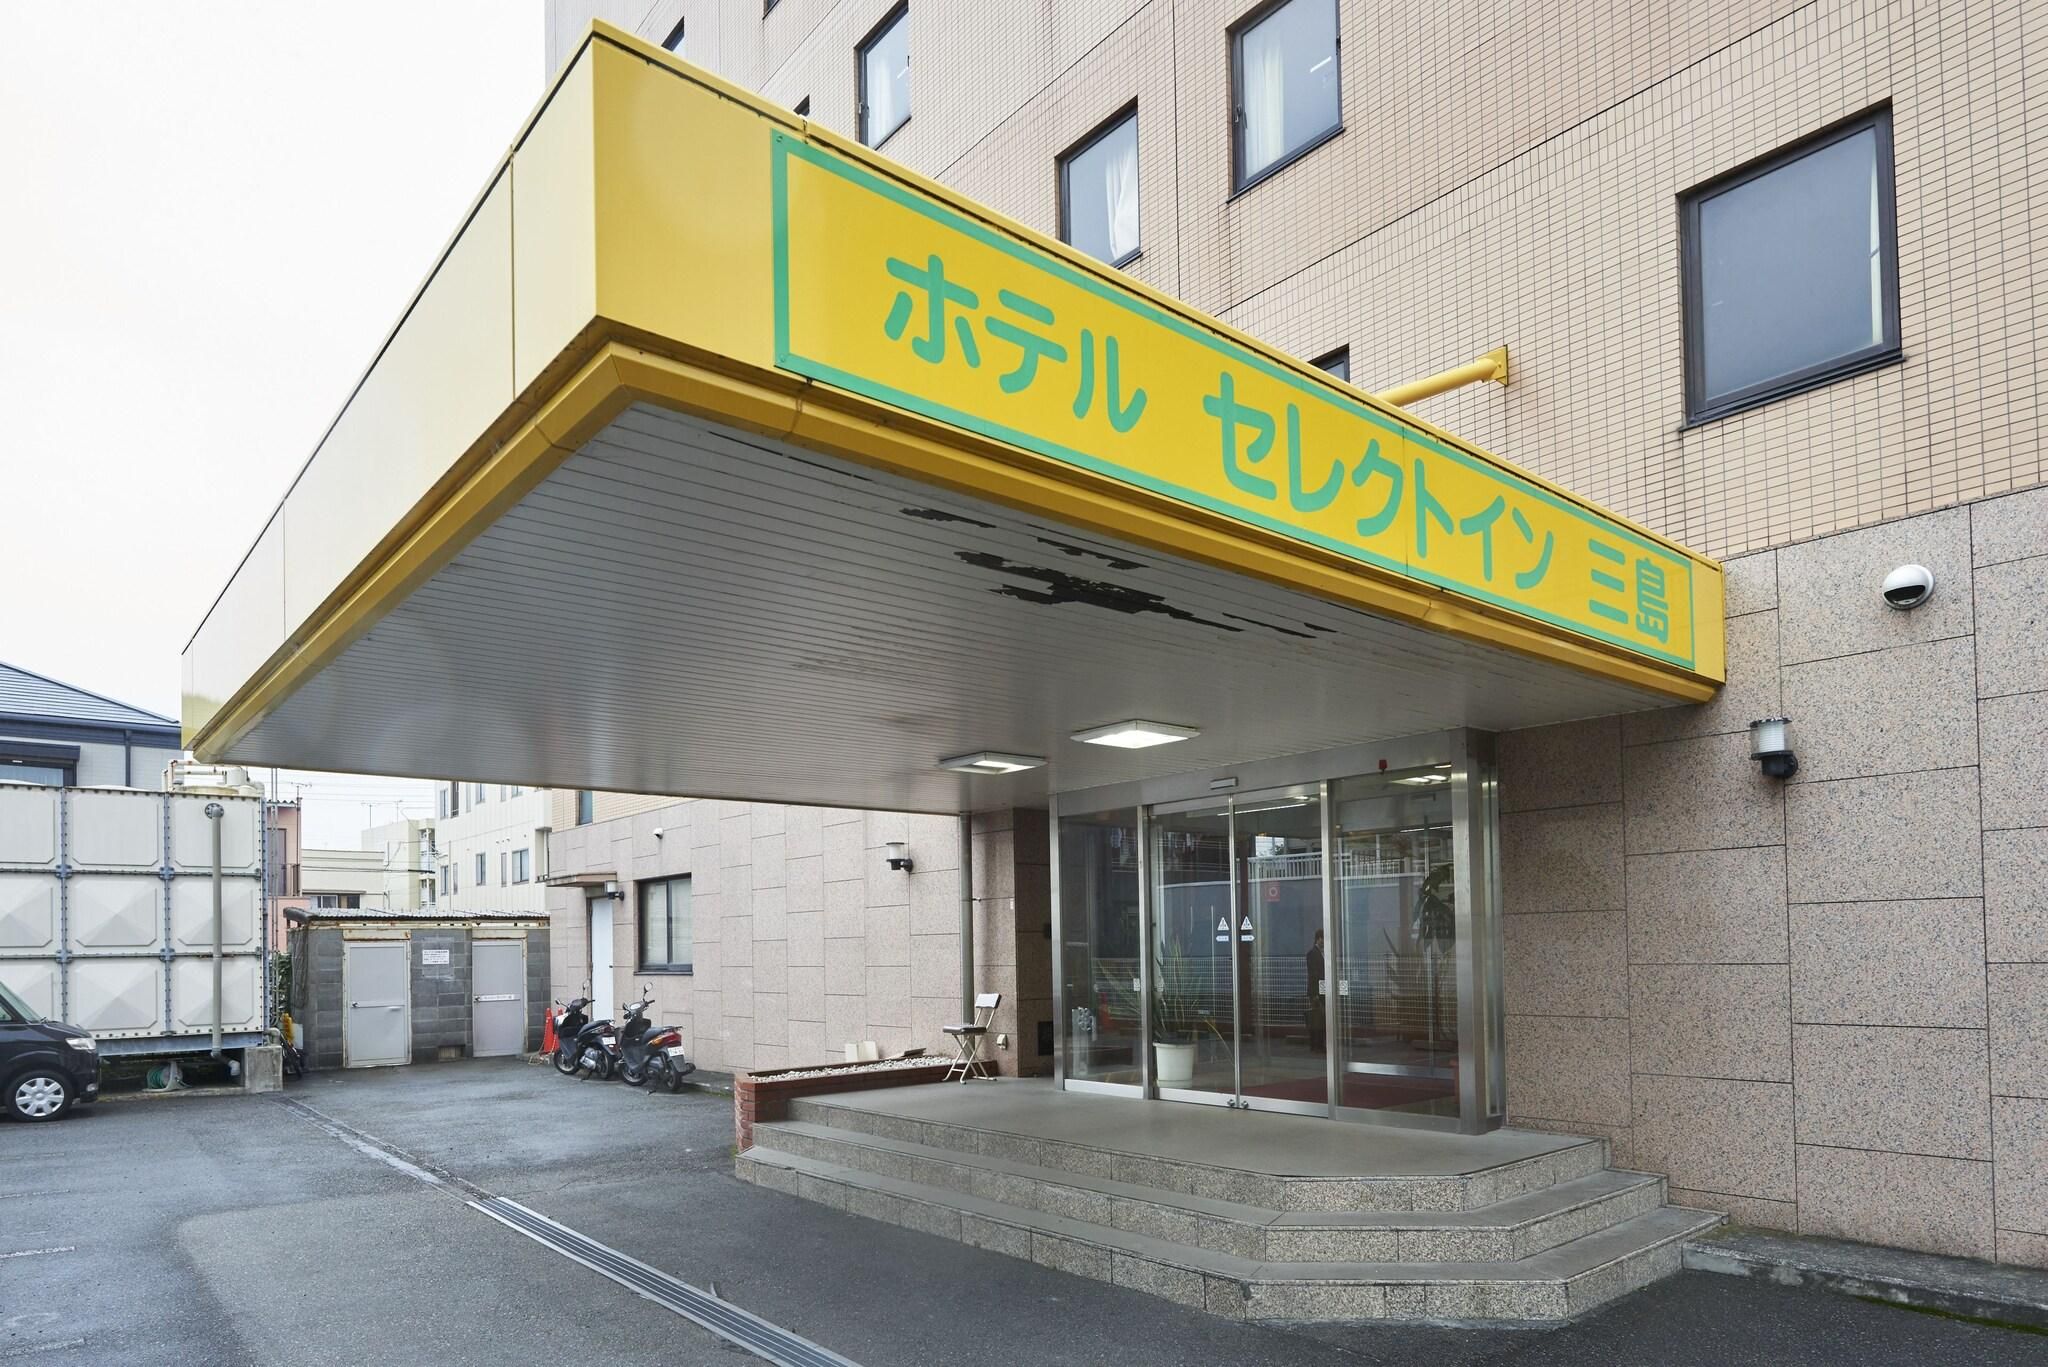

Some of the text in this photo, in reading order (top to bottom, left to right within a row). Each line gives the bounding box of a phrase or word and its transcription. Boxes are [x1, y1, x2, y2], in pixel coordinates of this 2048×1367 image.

[885, 254, 1669, 644] ホテル セレクトイン 三島
